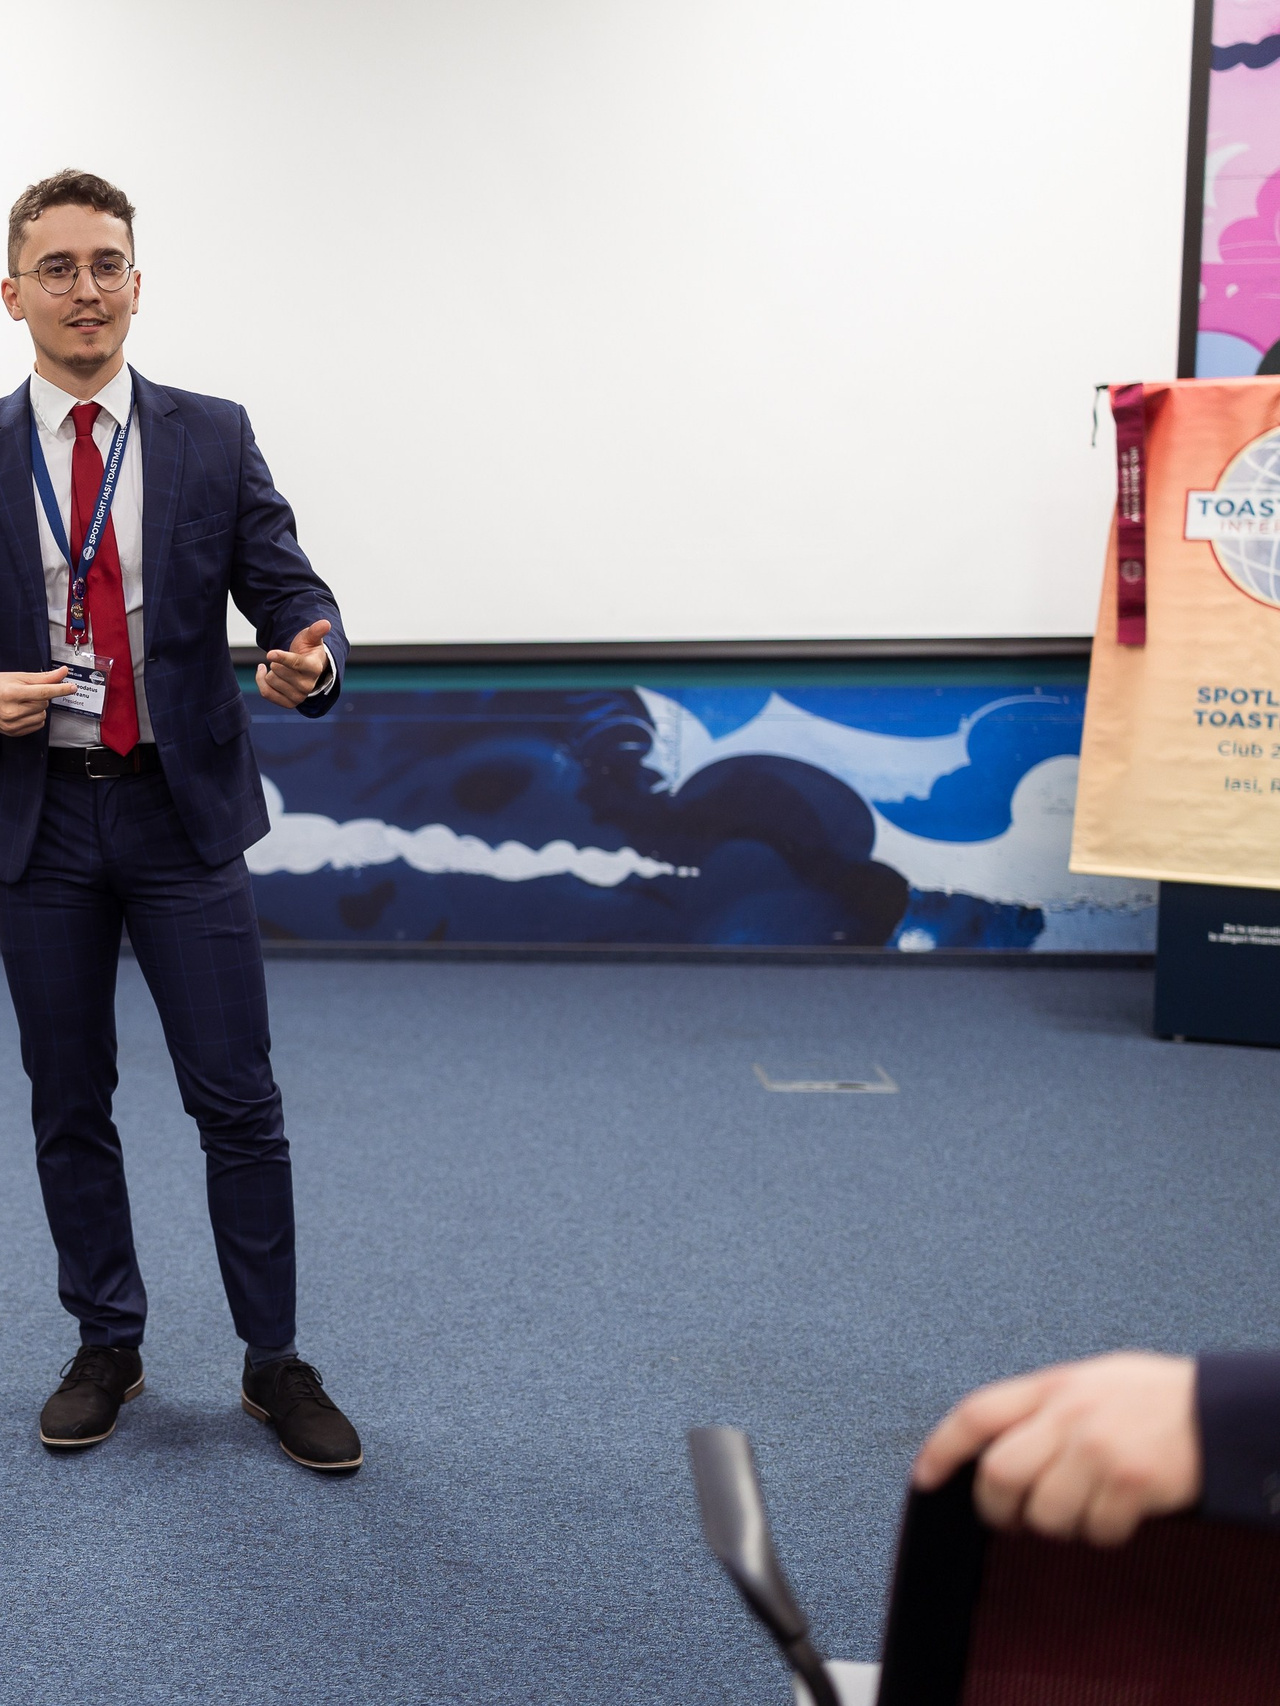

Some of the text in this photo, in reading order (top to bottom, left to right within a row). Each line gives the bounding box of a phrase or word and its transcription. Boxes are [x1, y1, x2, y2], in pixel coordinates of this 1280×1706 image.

[1198, 498, 1280, 517] TOAS
[88, 500, 107, 545] SPOTLIGHT
[63, 697, 84, 706] President
[1197, 686, 1280, 706] SPOTL
[1194, 708, 1280, 729] TOAST
[1217, 740, 1263, 758] Club
